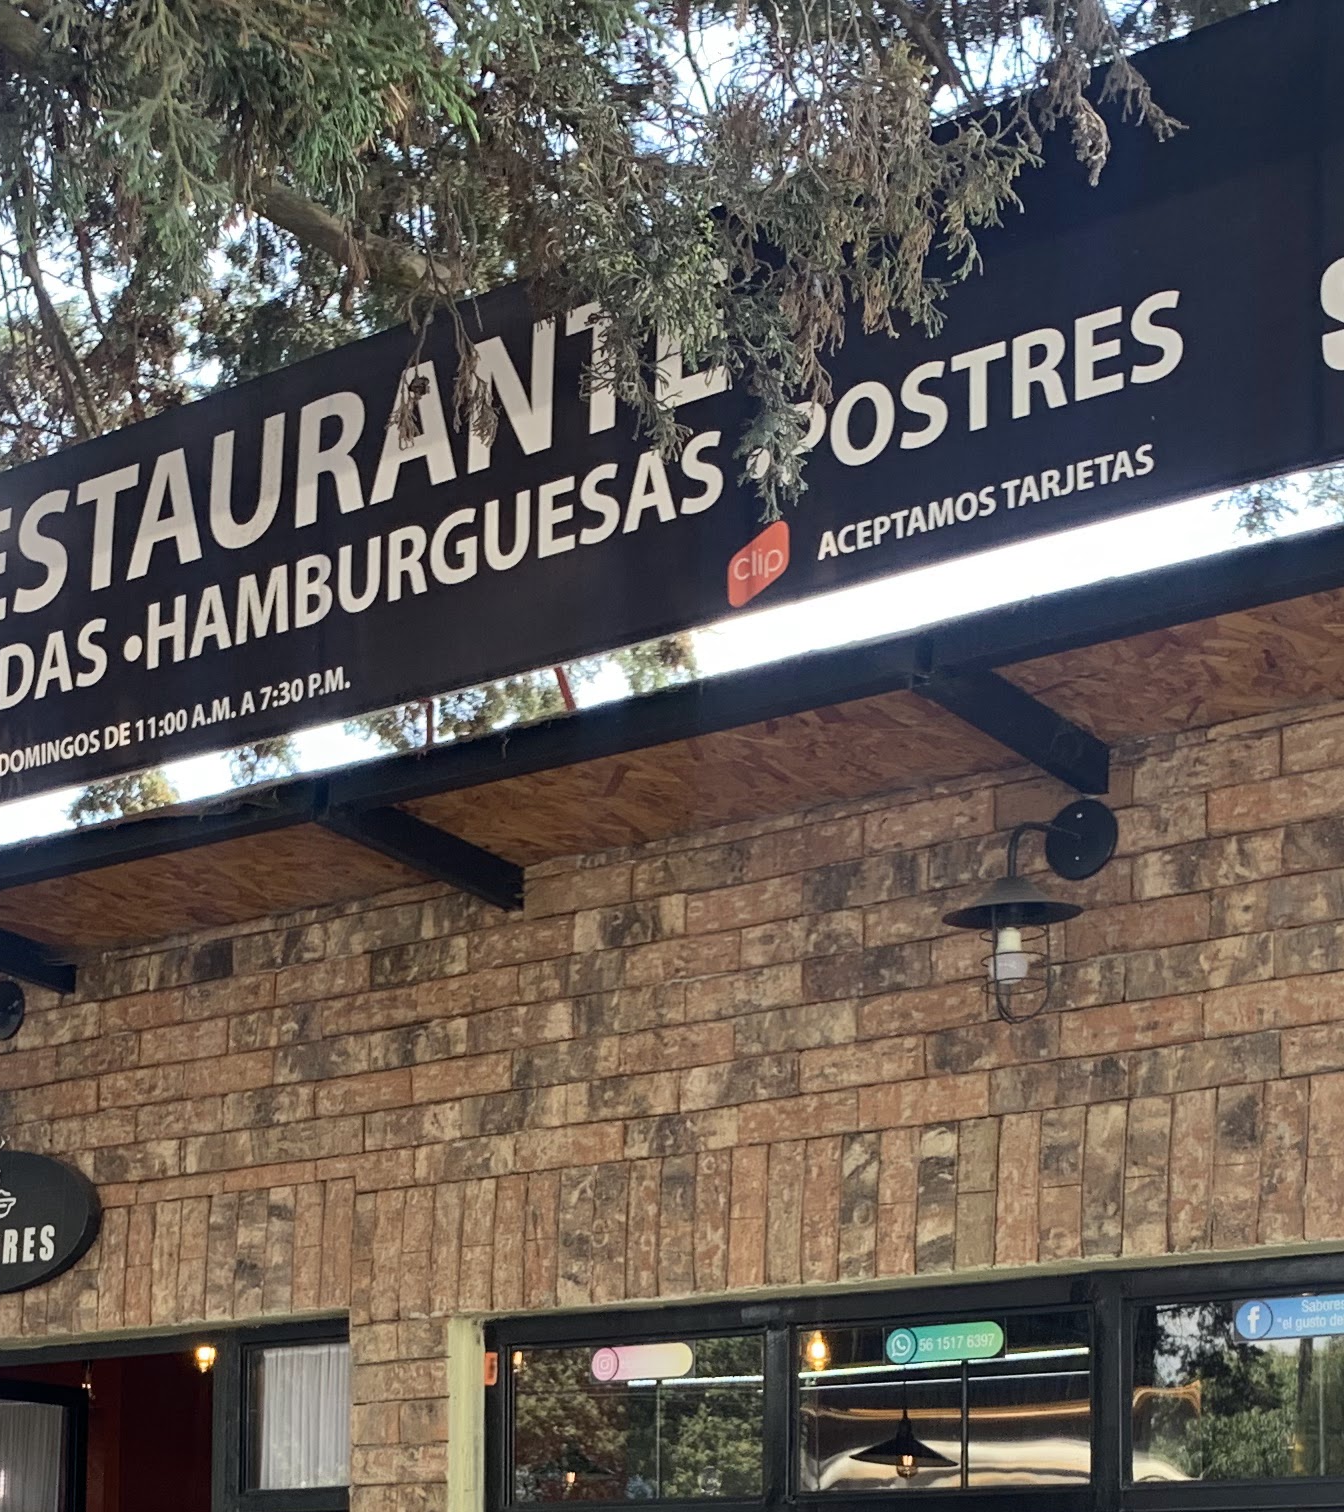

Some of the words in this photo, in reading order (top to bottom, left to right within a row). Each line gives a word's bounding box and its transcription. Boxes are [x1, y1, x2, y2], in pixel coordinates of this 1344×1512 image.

[817, 483, 997, 561] ACEPTAMOS
[1001, 444, 1155, 511] TARJETAS
[146, 430, 725, 670] HAMBURGUESAS
[733, 545, 787, 585] clip
[103, 724, 131, 751] DE
[135, 711, 189, 742] 11:00
[191, 697, 236, 729] A.M.
[240, 692, 256, 716] A
[259, 680, 304, 713] 7:30
[307, 665, 351, 699] P.M.
[919, 1337, 934, 1352] 56
[937, 1335, 964, 1350] 1517
[966, 1333, 996, 1348] 6397
[1295, 1314, 1327, 1331] gusto
